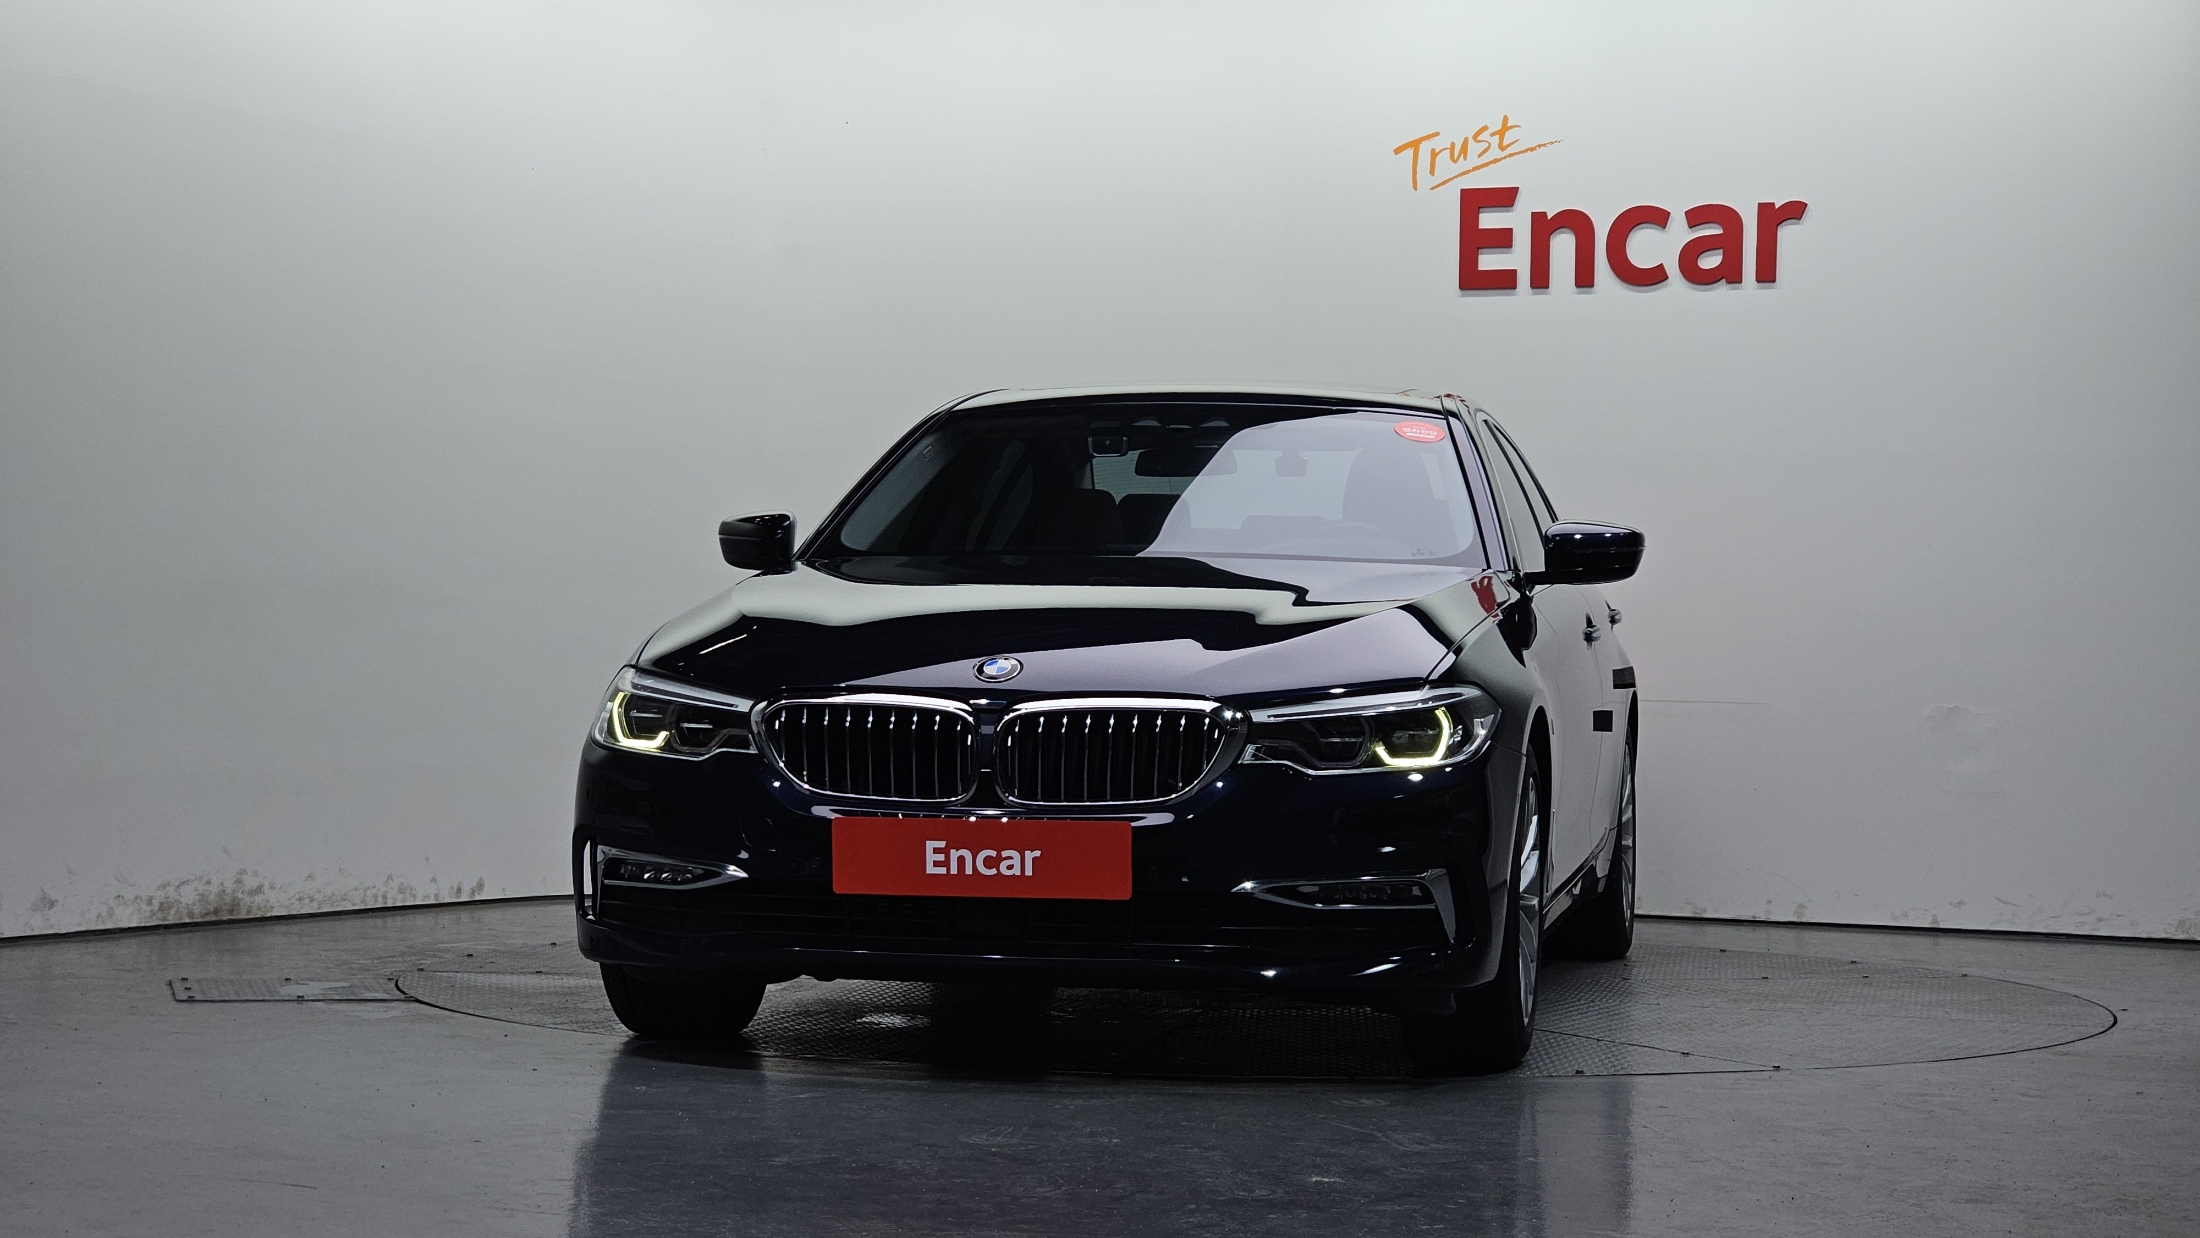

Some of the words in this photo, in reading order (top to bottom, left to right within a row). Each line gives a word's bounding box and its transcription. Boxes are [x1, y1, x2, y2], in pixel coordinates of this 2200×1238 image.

[1393, 114, 1522, 191] Trust
[1458, 186, 1808, 291] Encar
[925, 840, 1042, 877] Encar
